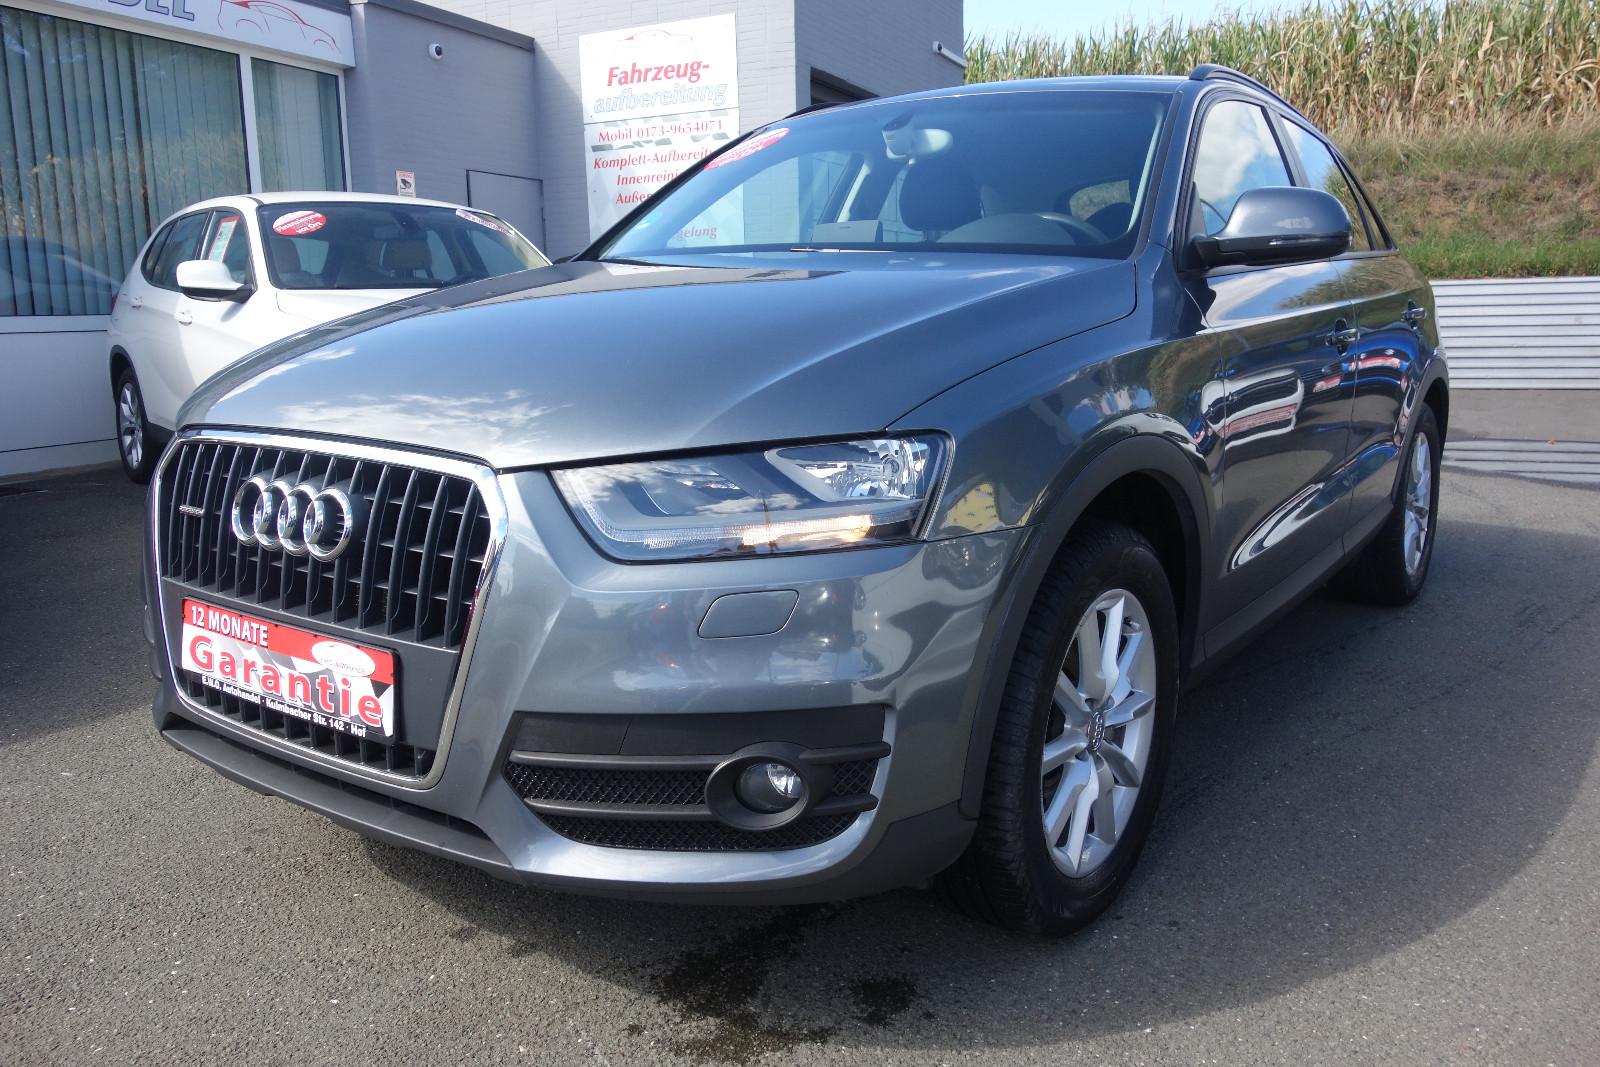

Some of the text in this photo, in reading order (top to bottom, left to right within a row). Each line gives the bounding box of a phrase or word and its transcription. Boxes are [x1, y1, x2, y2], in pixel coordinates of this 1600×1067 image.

[607, 61, 710, 87] Fahrzeug-
[593, 83, 728, 114] aufbereitung
[598, 119, 723, 143] Mobil 0173-9654071
[593, 148, 712, 170] Komplett-Aufbereit
[616, 168, 679, 186] Innenreini
[191, 605, 269, 647] 12 MONATE
[189, 634, 384, 728] Garantie
[222, 680, 261, 705] Autohandel
[265, 698, 311, 722] Kulmbacher
[313, 712, 327, 726] Str.
[329, 717, 345, 731] 142
[350, 724, 367, 738] Hof
